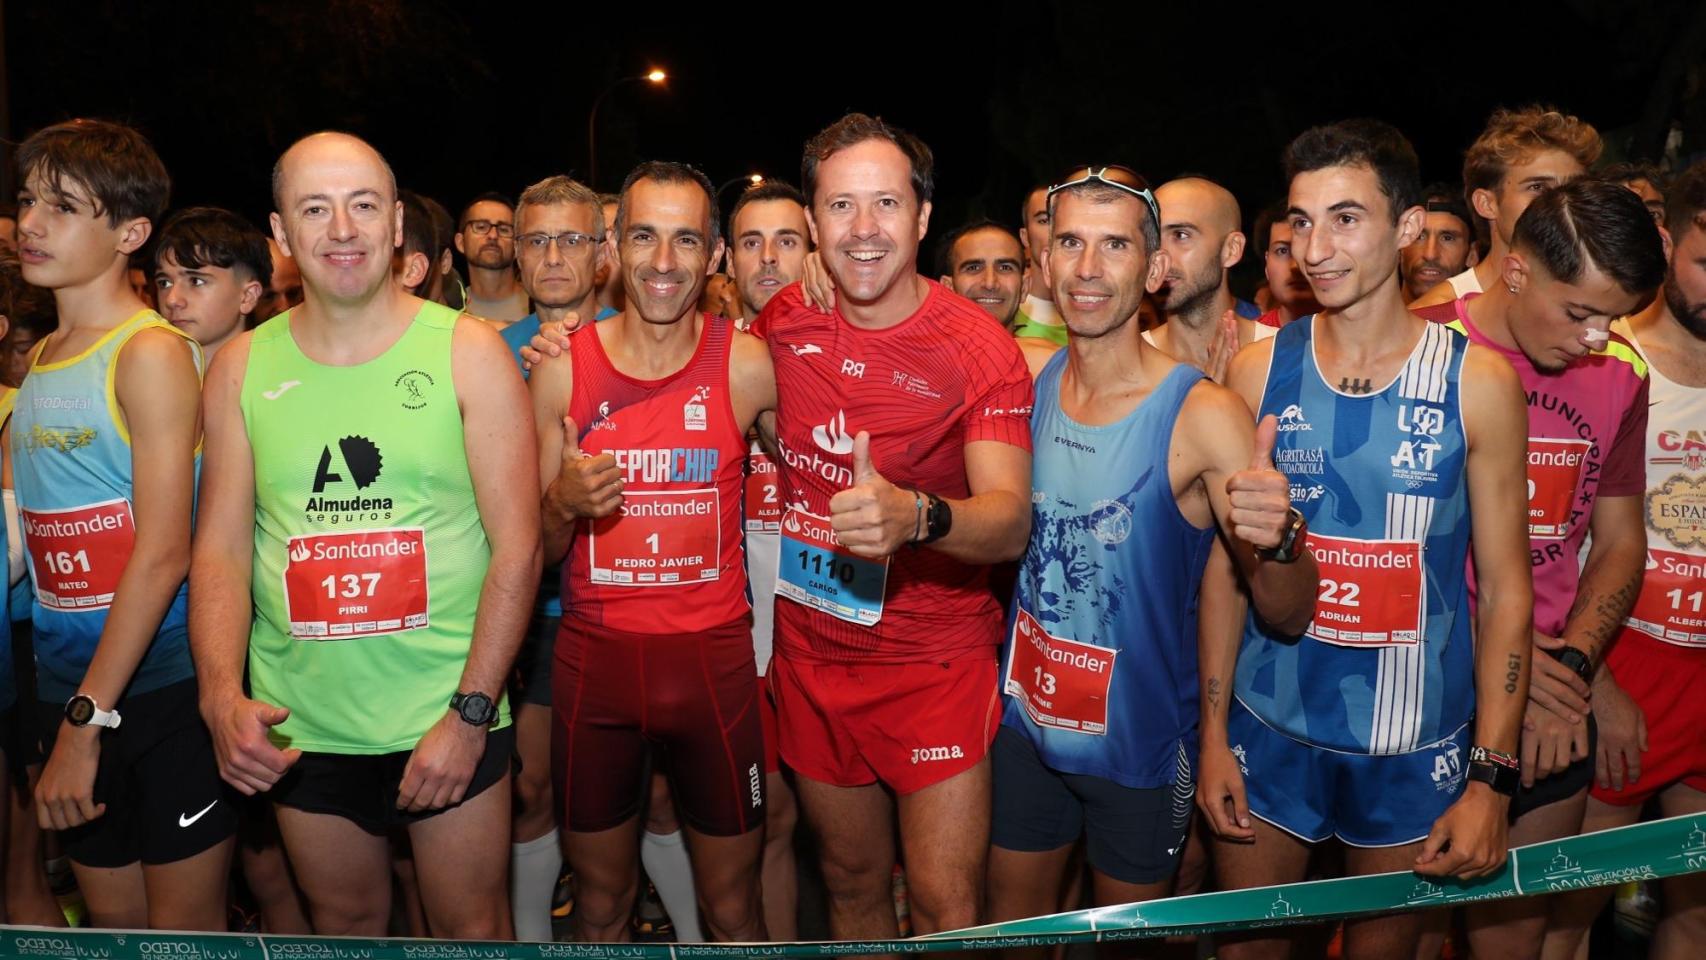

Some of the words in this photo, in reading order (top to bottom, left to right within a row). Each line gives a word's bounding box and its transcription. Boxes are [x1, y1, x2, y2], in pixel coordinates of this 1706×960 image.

[1054, 436, 1096, 454] EVERNYA
[1657, 430, 1706, 451] CA
[1275, 446, 1324, 463] AGRITRASA
[601, 447, 719, 483] EPORCHIP
[305, 496, 393, 512] Almudena
[1528, 509, 1545, 517] RO
[1660, 503, 1706, 519] ESPA
[32, 512, 124, 537] Santander
[306, 512, 391, 524] seguros
[314, 538, 418, 561] Santander
[646, 533, 659, 554] 1
[45, 550, 91, 574] 161
[614, 558, 656, 568] PEDRO
[660, 556, 703, 567] JAVIER
[798, 550, 854, 584] 1110
[58, 581, 89, 590] MATEO
[321, 573, 381, 599] 137
[808, 580, 838, 596] CARLOS
[1319, 579, 1360, 607] 22
[338, 605, 368, 615] PIRRI
[1319, 610, 1360, 624] ADRIÁN
[1030, 628, 1107, 673] Santander
[1034, 666, 1056, 695] 13
[1505, 652, 1521, 694] 1500
[1033, 693, 1053, 709] JAIME
[911, 745, 964, 764] joma
[749, 763, 761, 808] joma
[1587, 866, 1639, 882] DIPUTACIÓN
[1640, 864, 1653, 873] DE
[15, 938, 73, 950] TOLEDO
[139, 942, 201, 954] TOLEDO
[269, 943, 333, 953] TOLEDO
